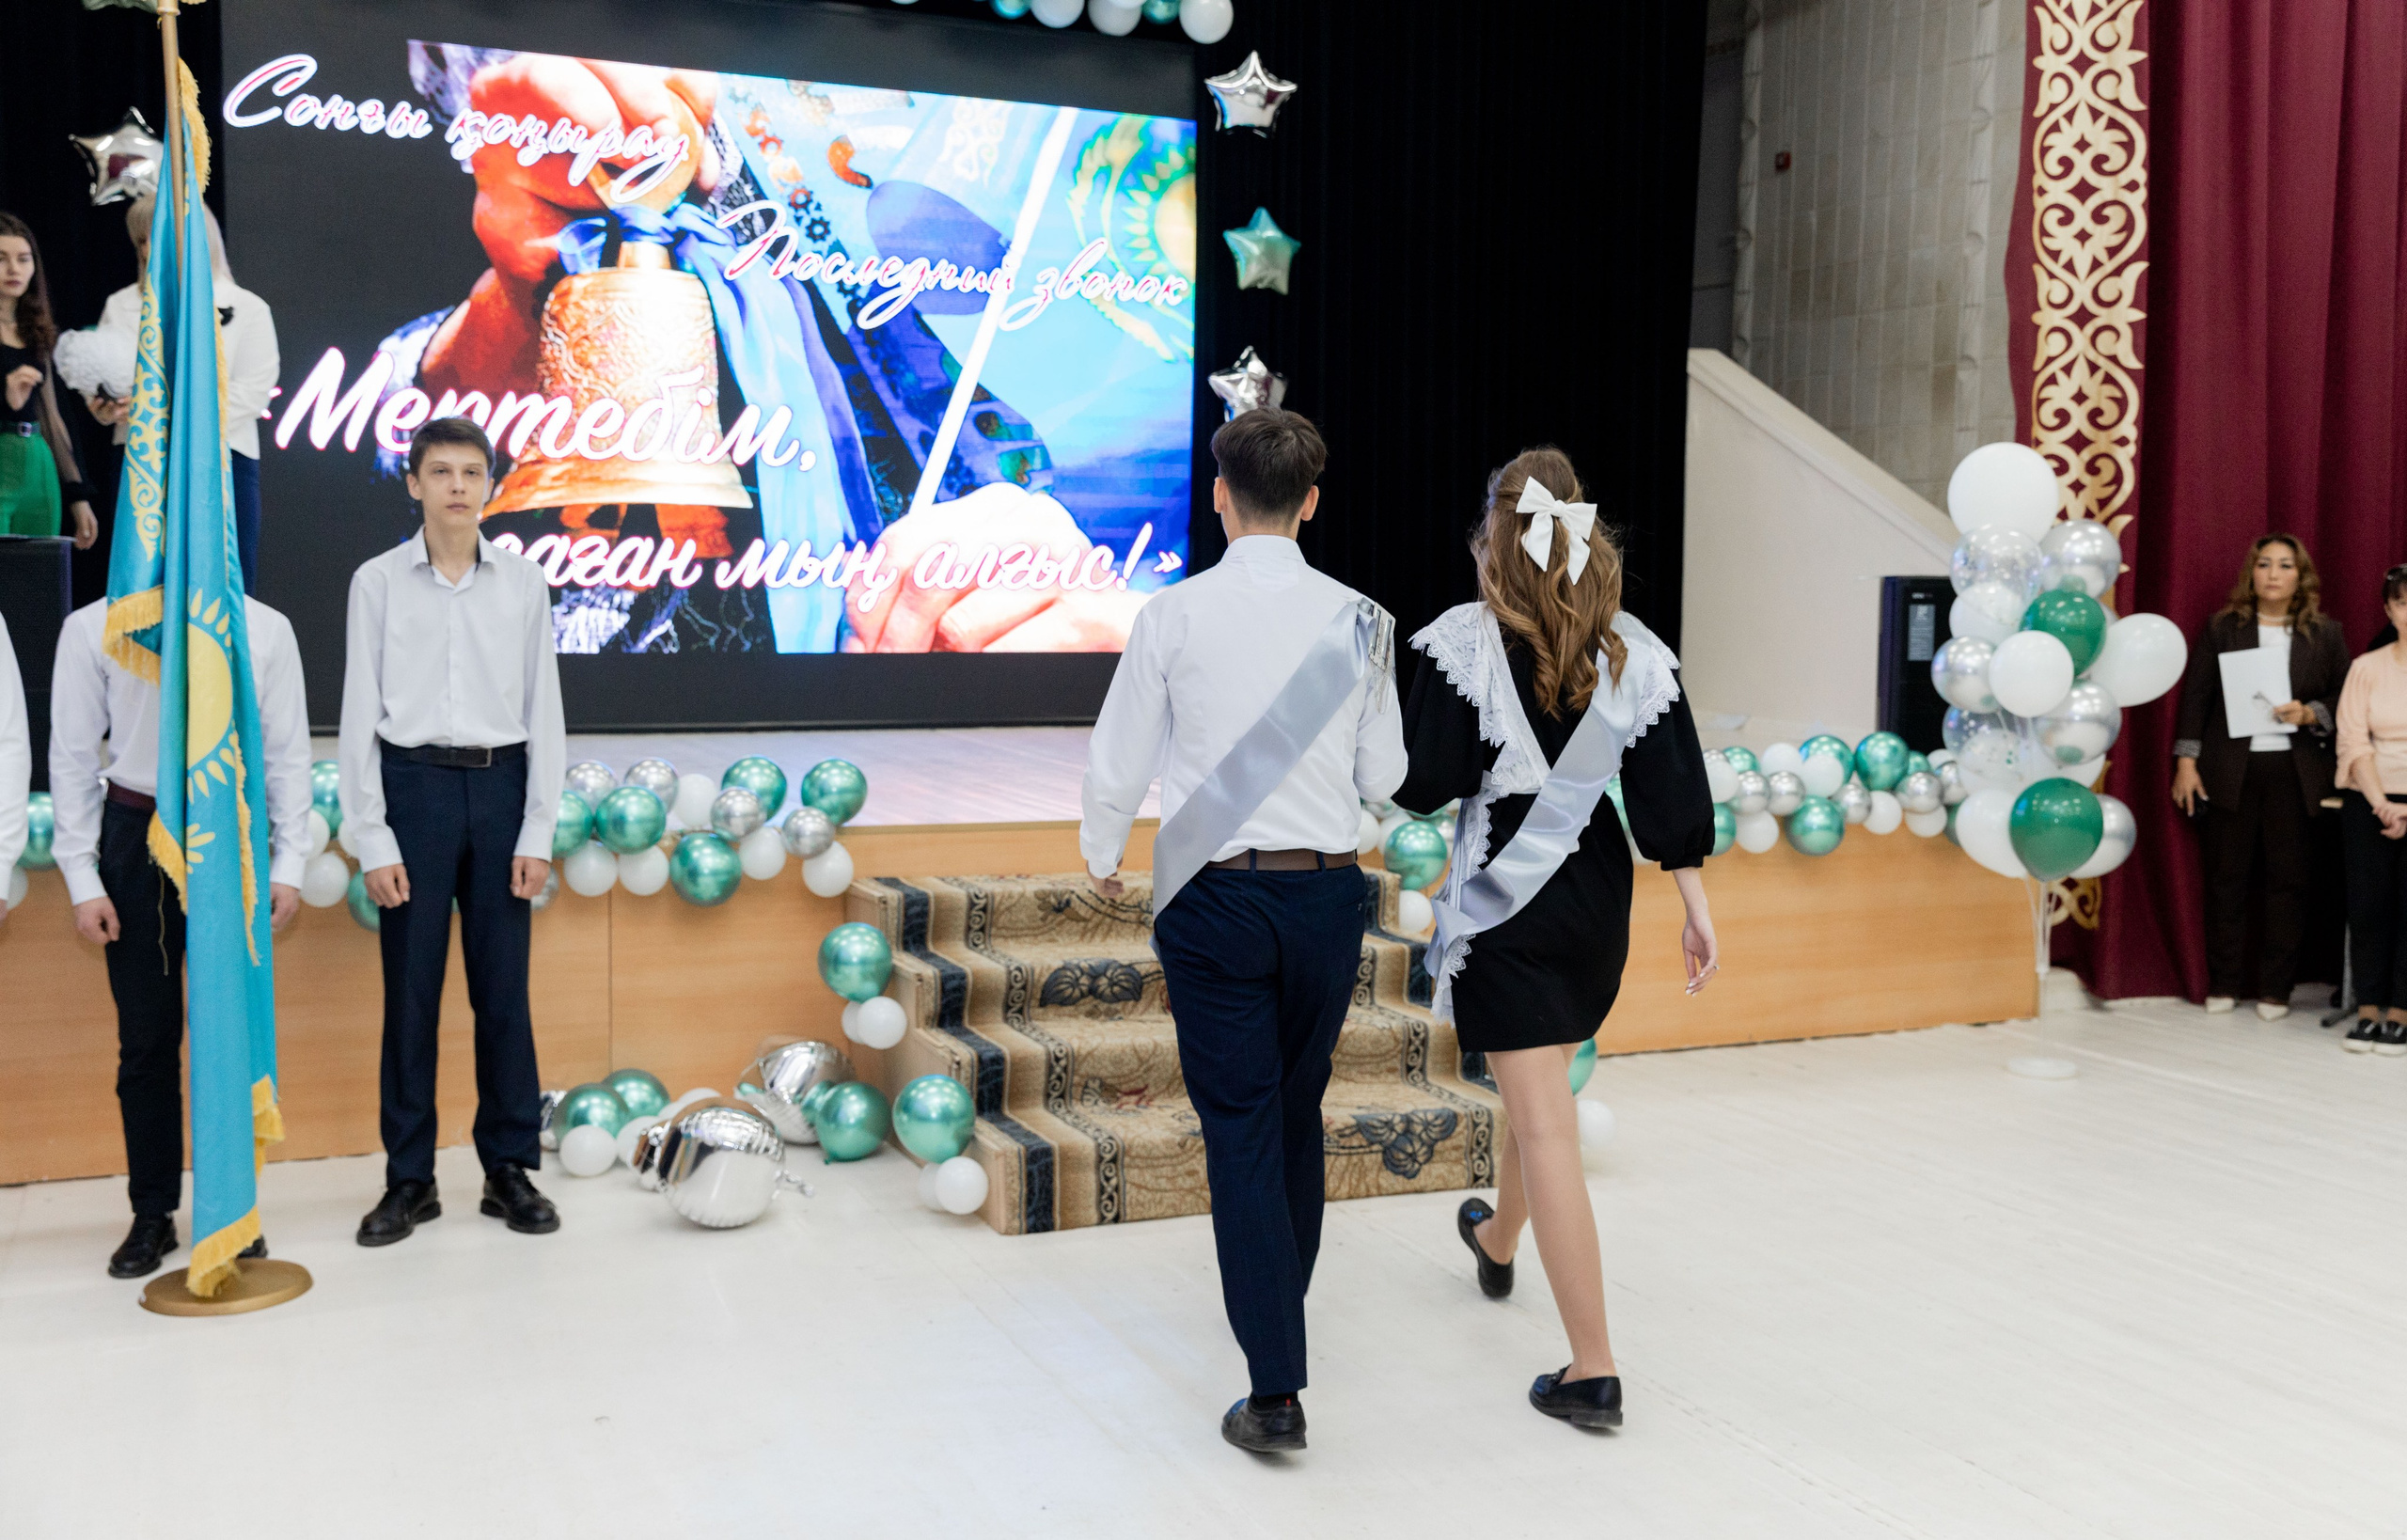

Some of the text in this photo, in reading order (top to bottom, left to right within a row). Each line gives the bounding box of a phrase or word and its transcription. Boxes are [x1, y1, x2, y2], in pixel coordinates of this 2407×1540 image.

[716, 200, 1188, 331] Последний звонок
[261, 346, 816, 471] Метебім,
[491, 532, 702, 587] аған
[715, 538, 899, 613] мың
